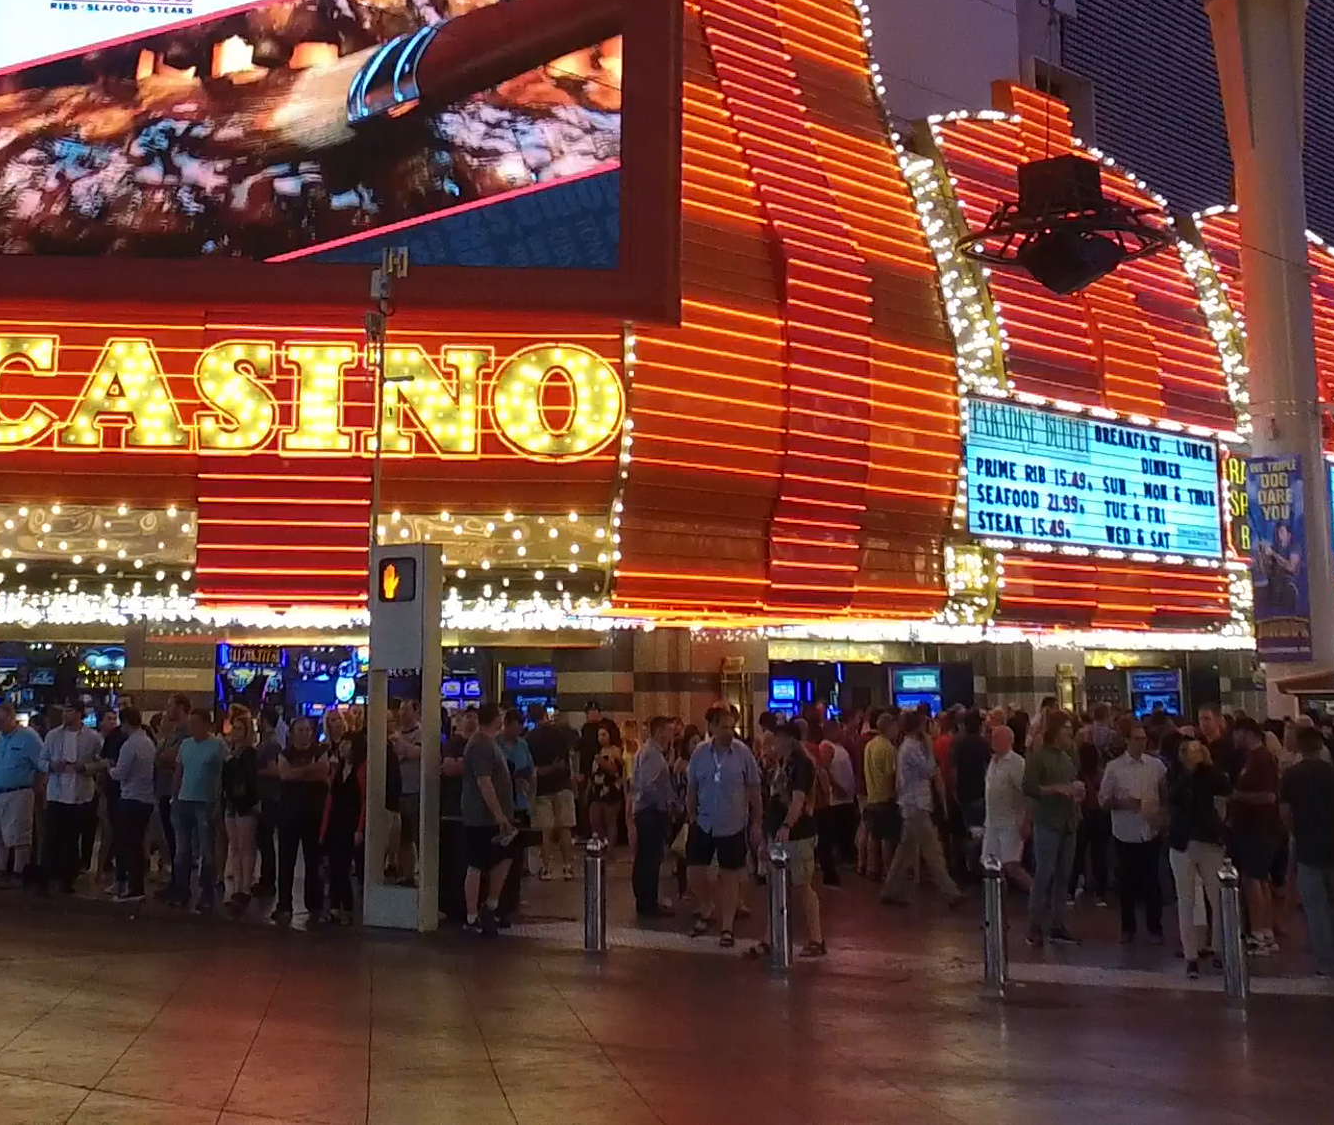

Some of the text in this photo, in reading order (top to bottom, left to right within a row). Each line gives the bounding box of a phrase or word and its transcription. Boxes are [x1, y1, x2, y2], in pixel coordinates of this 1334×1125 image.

[50, 2, 193, 15] RIBS SEAFOOD STEAKS
[1176, 439, 1214, 462] LUNCH
[976, 456, 1018, 482] PRIME
[1024, 463, 1047, 485] RIB
[1143, 481, 1169, 501] MON
[1174, 485, 1182, 503] &
[1141, 457, 1183, 480] DINNER
[1259, 473, 1289, 489] DOG
[976, 482, 1040, 509] SEAFOOD
[1104, 500, 1128, 521] TUE
[1133, 504, 1141, 522] &
[1147, 506, 1167, 525] FRI
[1257, 488, 1293, 506] DARE
[1262, 505, 1291, 521] YOU
[977, 510, 1024, 536] STEAK
[1105, 524, 1132, 545] WED
[1137, 527, 1145, 546] &
[1150, 530, 1171, 550] SAT
